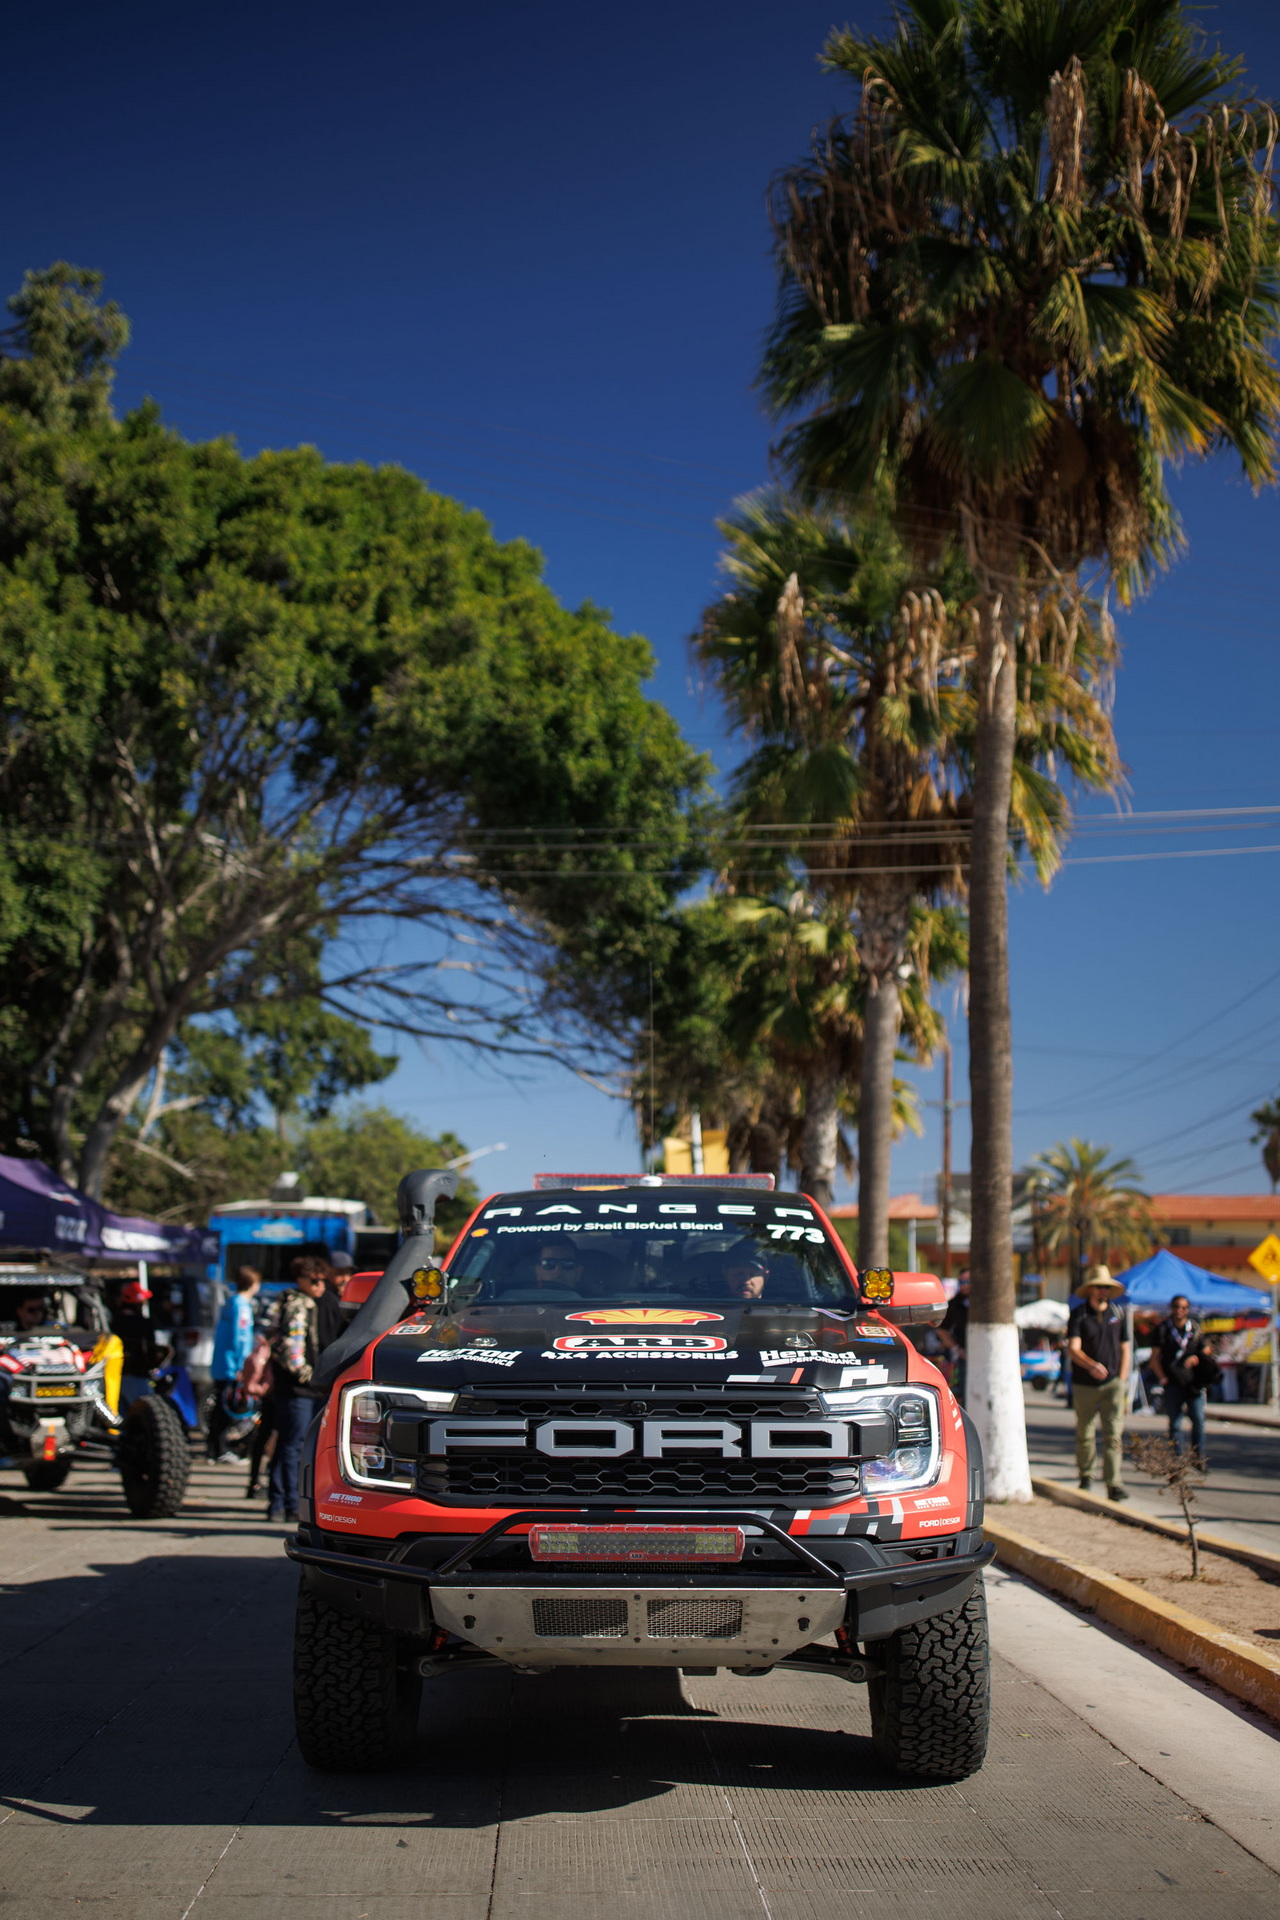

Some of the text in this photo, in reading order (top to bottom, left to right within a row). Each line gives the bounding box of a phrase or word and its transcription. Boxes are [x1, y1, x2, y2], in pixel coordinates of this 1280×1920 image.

[483, 1203, 814, 1221] RANGER
[497, 1222, 723, 1234] Powered by Shell Biofuel Blend
[766, 1224, 825, 1244] 773
[574, 1337, 710, 1348] ARB
[420, 1349, 522, 1361] Herrod
[441, 1354, 516, 1368] PERFORMANCE
[595, 1350, 739, 1360] ACCESSORIES
[759, 1350, 857, 1361] Herrod
[789, 1357, 862, 1366] PERFORMANCE
[428, 1419, 851, 1458] FORD
[330, 1492, 363, 1503] METHOD
[319, 1512, 357, 1524] FORD DESIGN
[919, 1516, 961, 1528] FORD DESIGN
